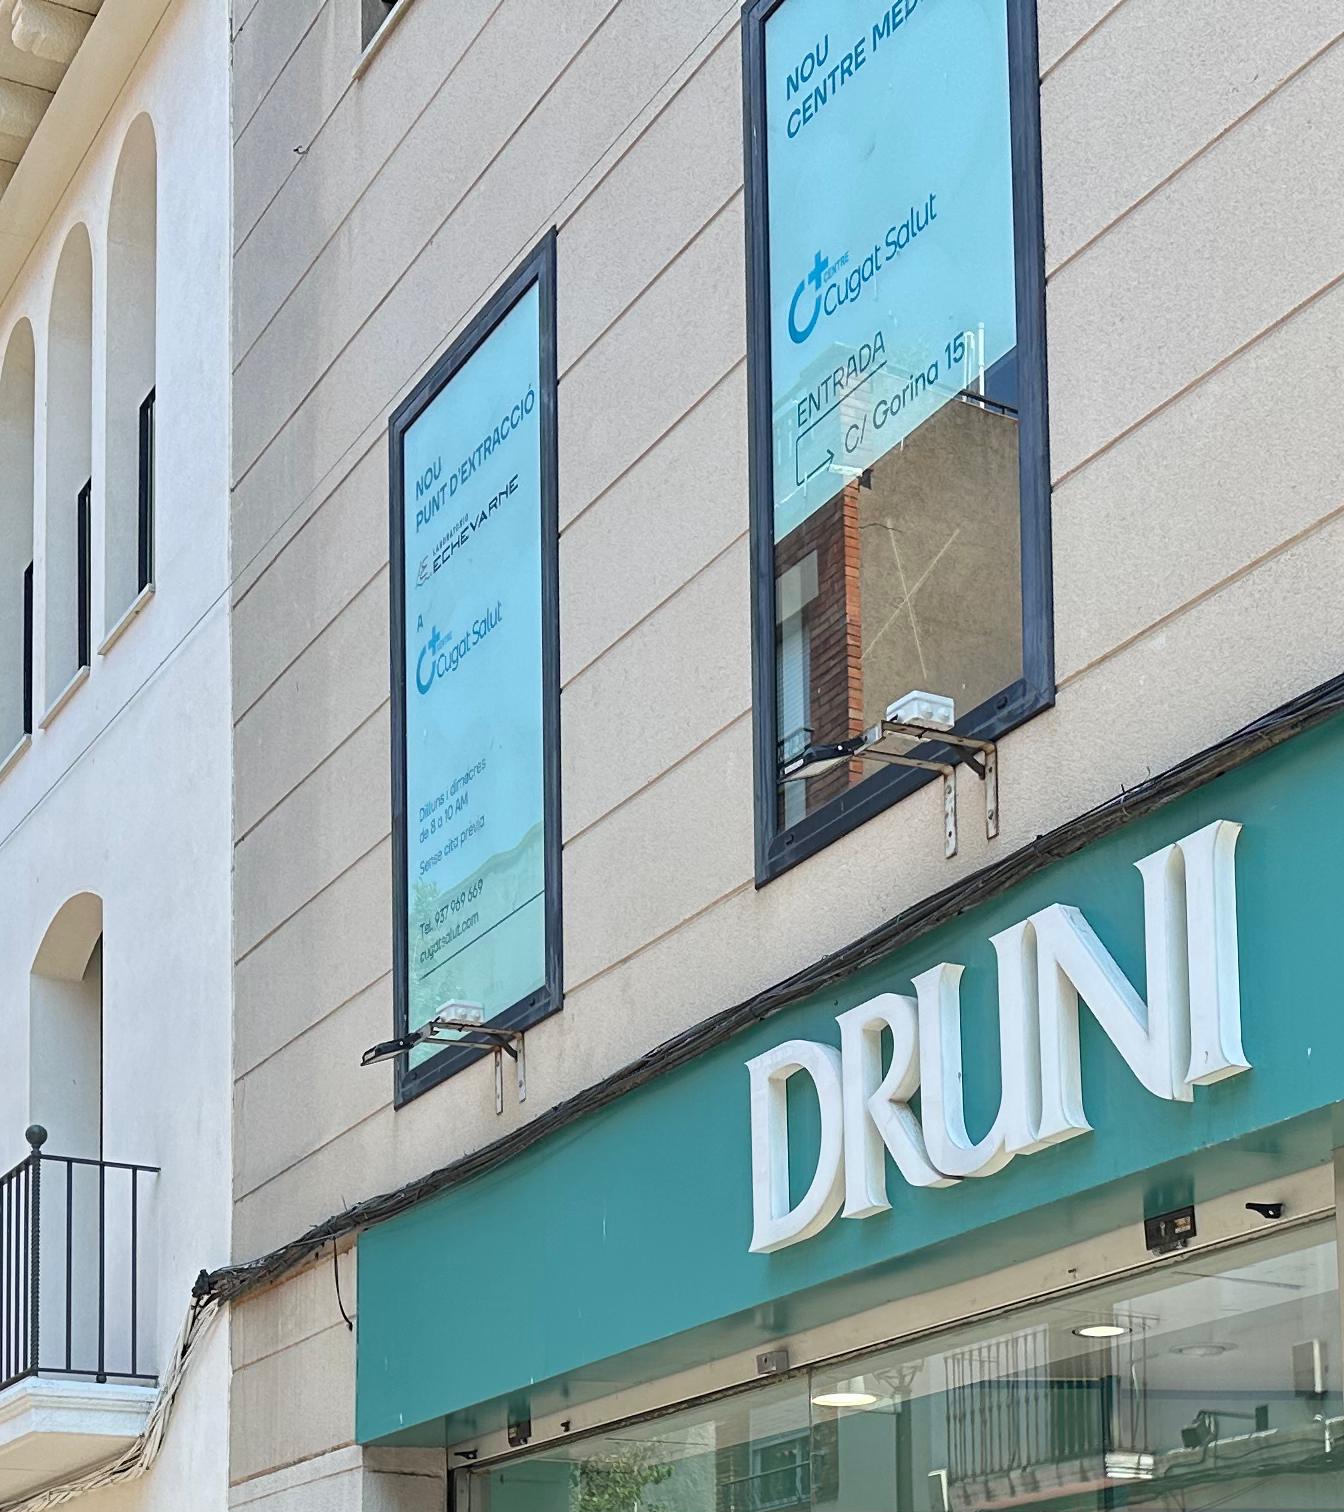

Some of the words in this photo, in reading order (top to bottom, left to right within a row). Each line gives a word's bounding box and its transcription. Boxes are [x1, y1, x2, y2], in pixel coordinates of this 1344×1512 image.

[786, 34, 829, 101] NOU
[786, 37, 866, 138] CENTRE
[872, 0, 923, 52] MED
[823, 246, 881, 316] Cugat
[885, 193, 938, 261] Salut
[797, 330, 886, 427] ENTRADA
[844, 413, 867, 453] C/
[872, 360, 938, 429] Gorina
[944, 331, 965, 370] 15
[415, 456, 442, 501] NOU
[416, 482, 447, 533] PUNT
[449, 383, 535, 498] D'EXTRACCIÓ
[433, 474, 519, 574] ECHEVARNE
[416, 613, 424, 633] A
[437, 631, 471, 678] Cugat
[472, 600, 503, 646] Salut
[744, 819, 1253, 1254] DRUNI
